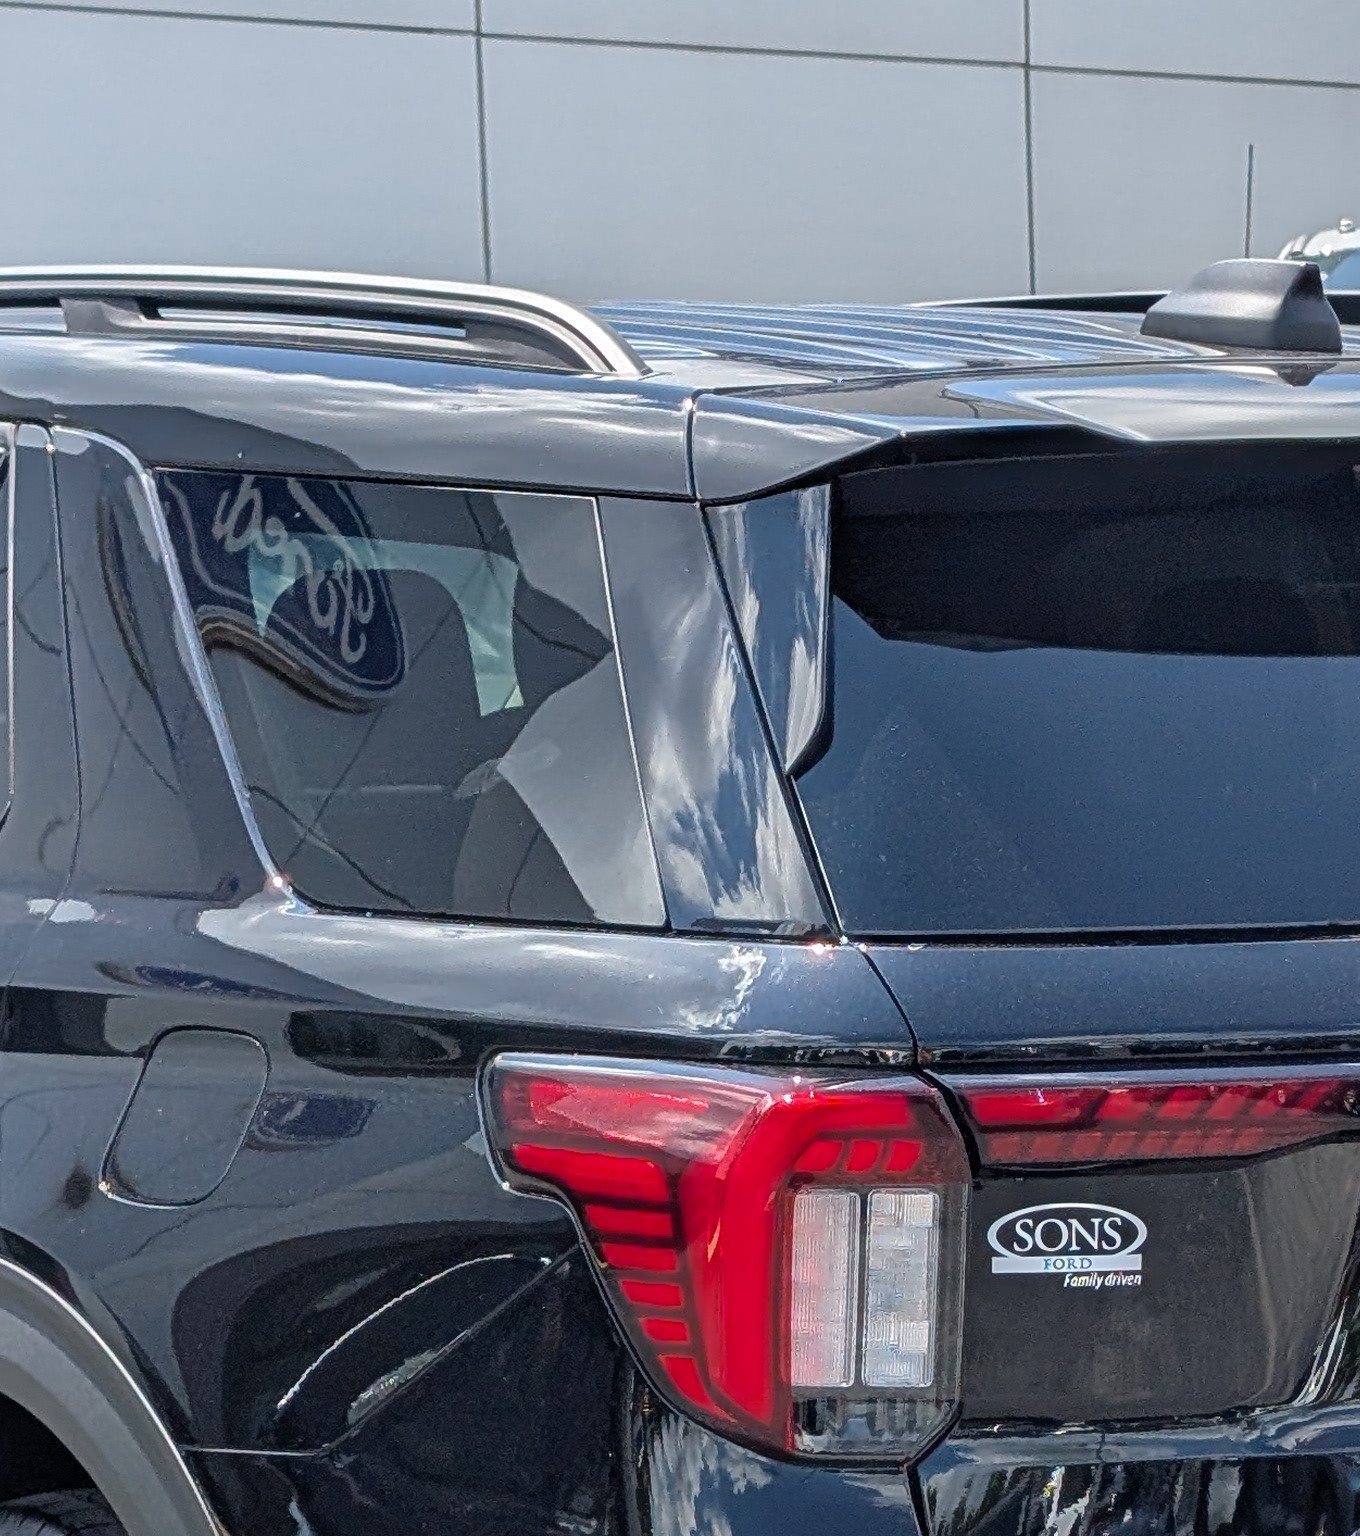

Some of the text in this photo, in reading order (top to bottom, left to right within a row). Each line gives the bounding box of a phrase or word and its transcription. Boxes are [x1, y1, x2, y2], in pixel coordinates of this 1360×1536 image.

[1013, 1217, 1122, 1252] SONS
[1043, 1257, 1093, 1270] FORD
[1063, 1270, 1142, 1290] Family driven
